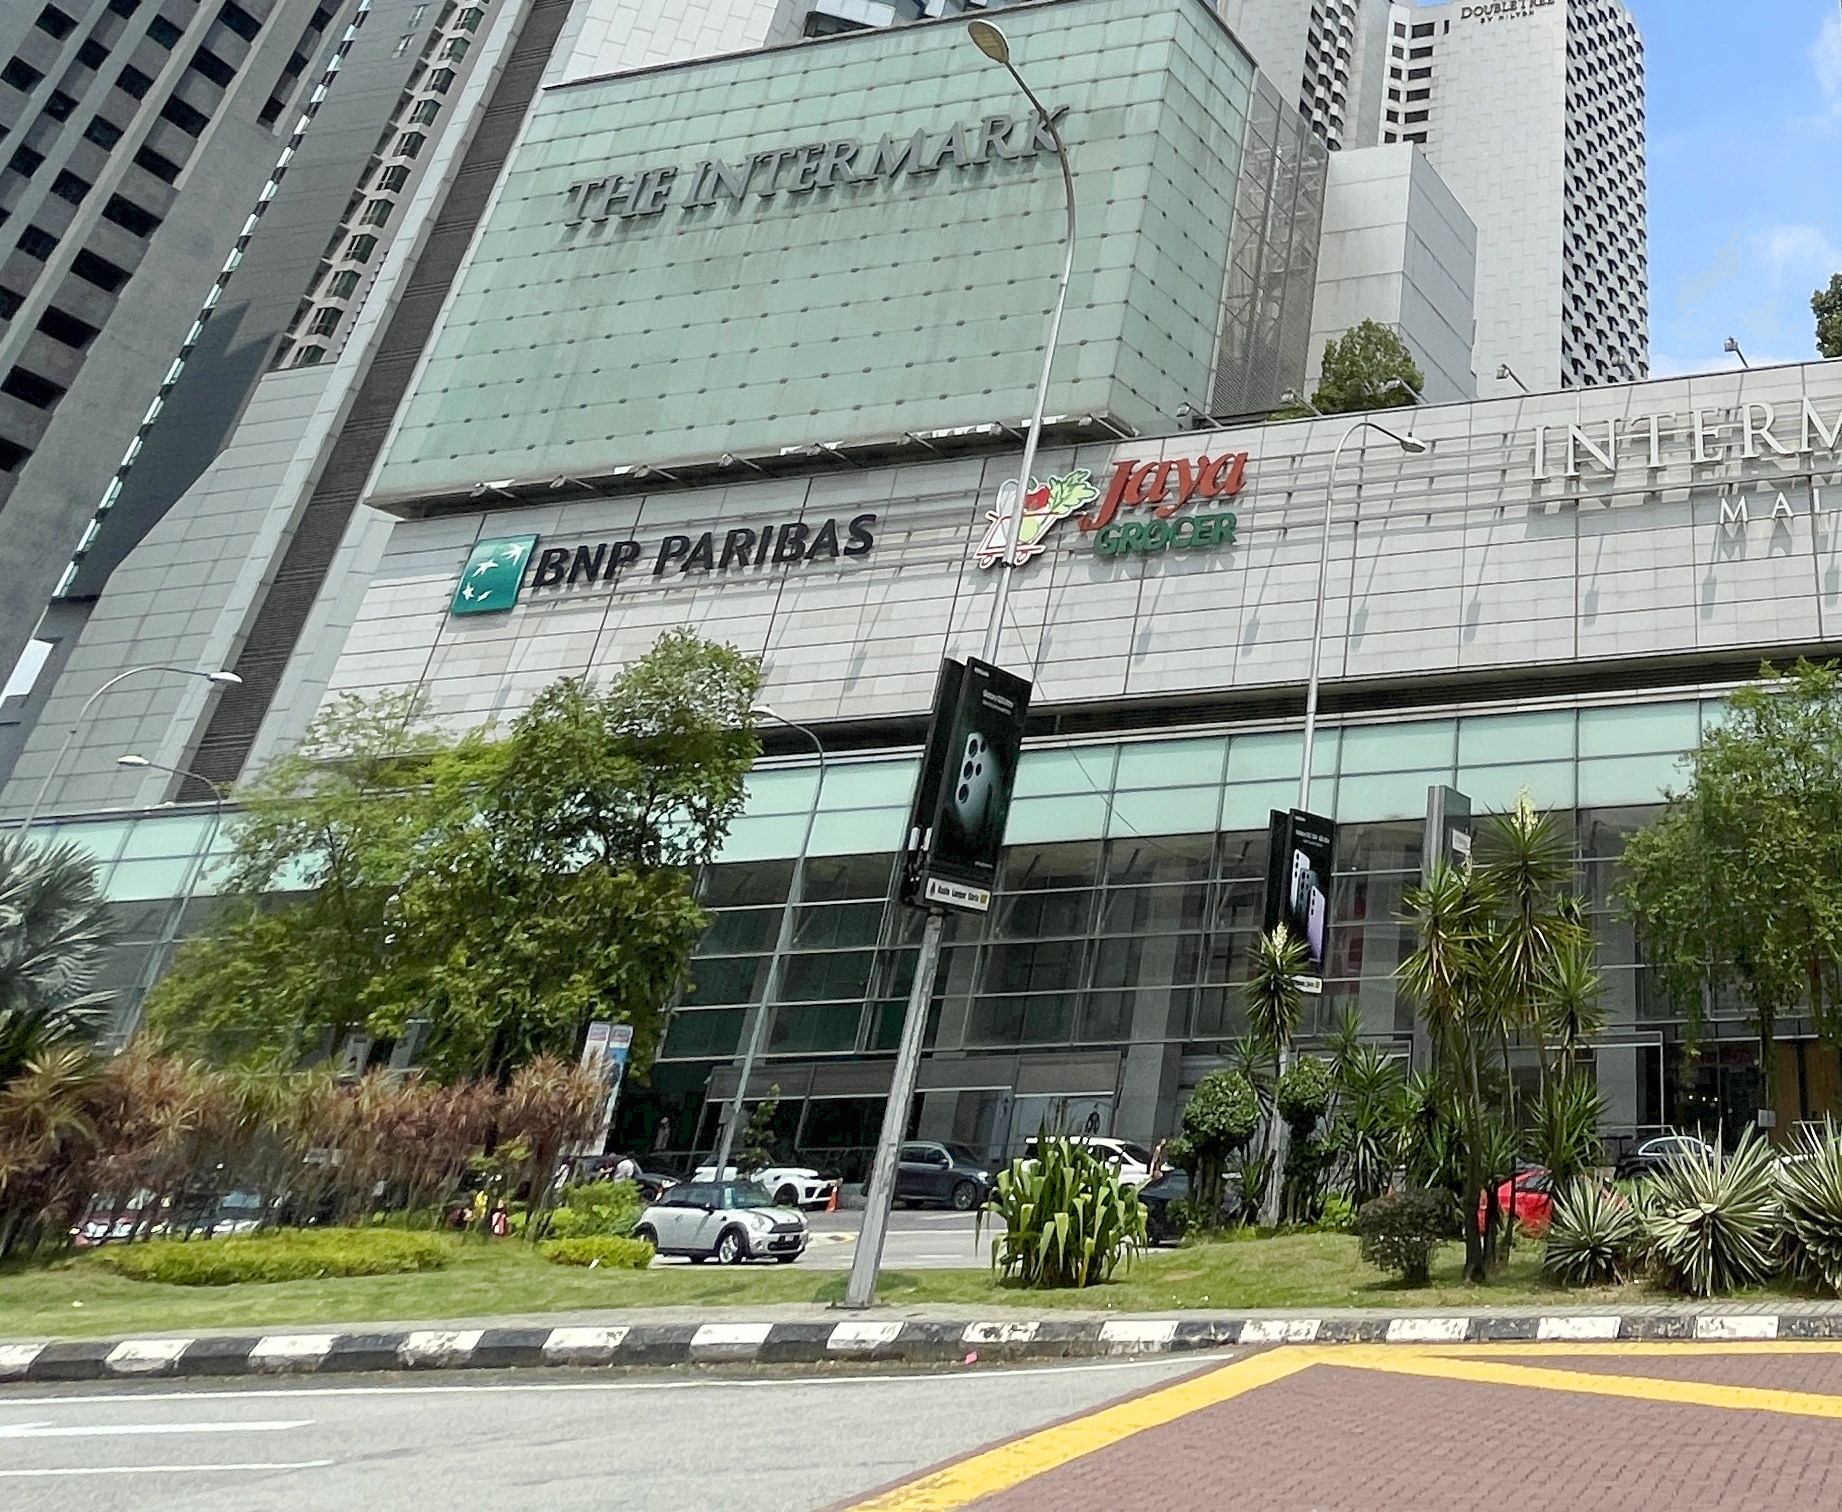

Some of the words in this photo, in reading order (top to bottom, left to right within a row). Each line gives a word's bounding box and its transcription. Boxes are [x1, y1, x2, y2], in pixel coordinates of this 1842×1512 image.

[565, 166, 678, 226] THE
[681, 105, 1069, 210] INTERMARK
[1078, 452, 1249, 533] Jaya
[533, 540, 641, 588] BNP
[653, 514, 877, 575] PARIBAS
[1094, 513, 1237, 556] GROCER
